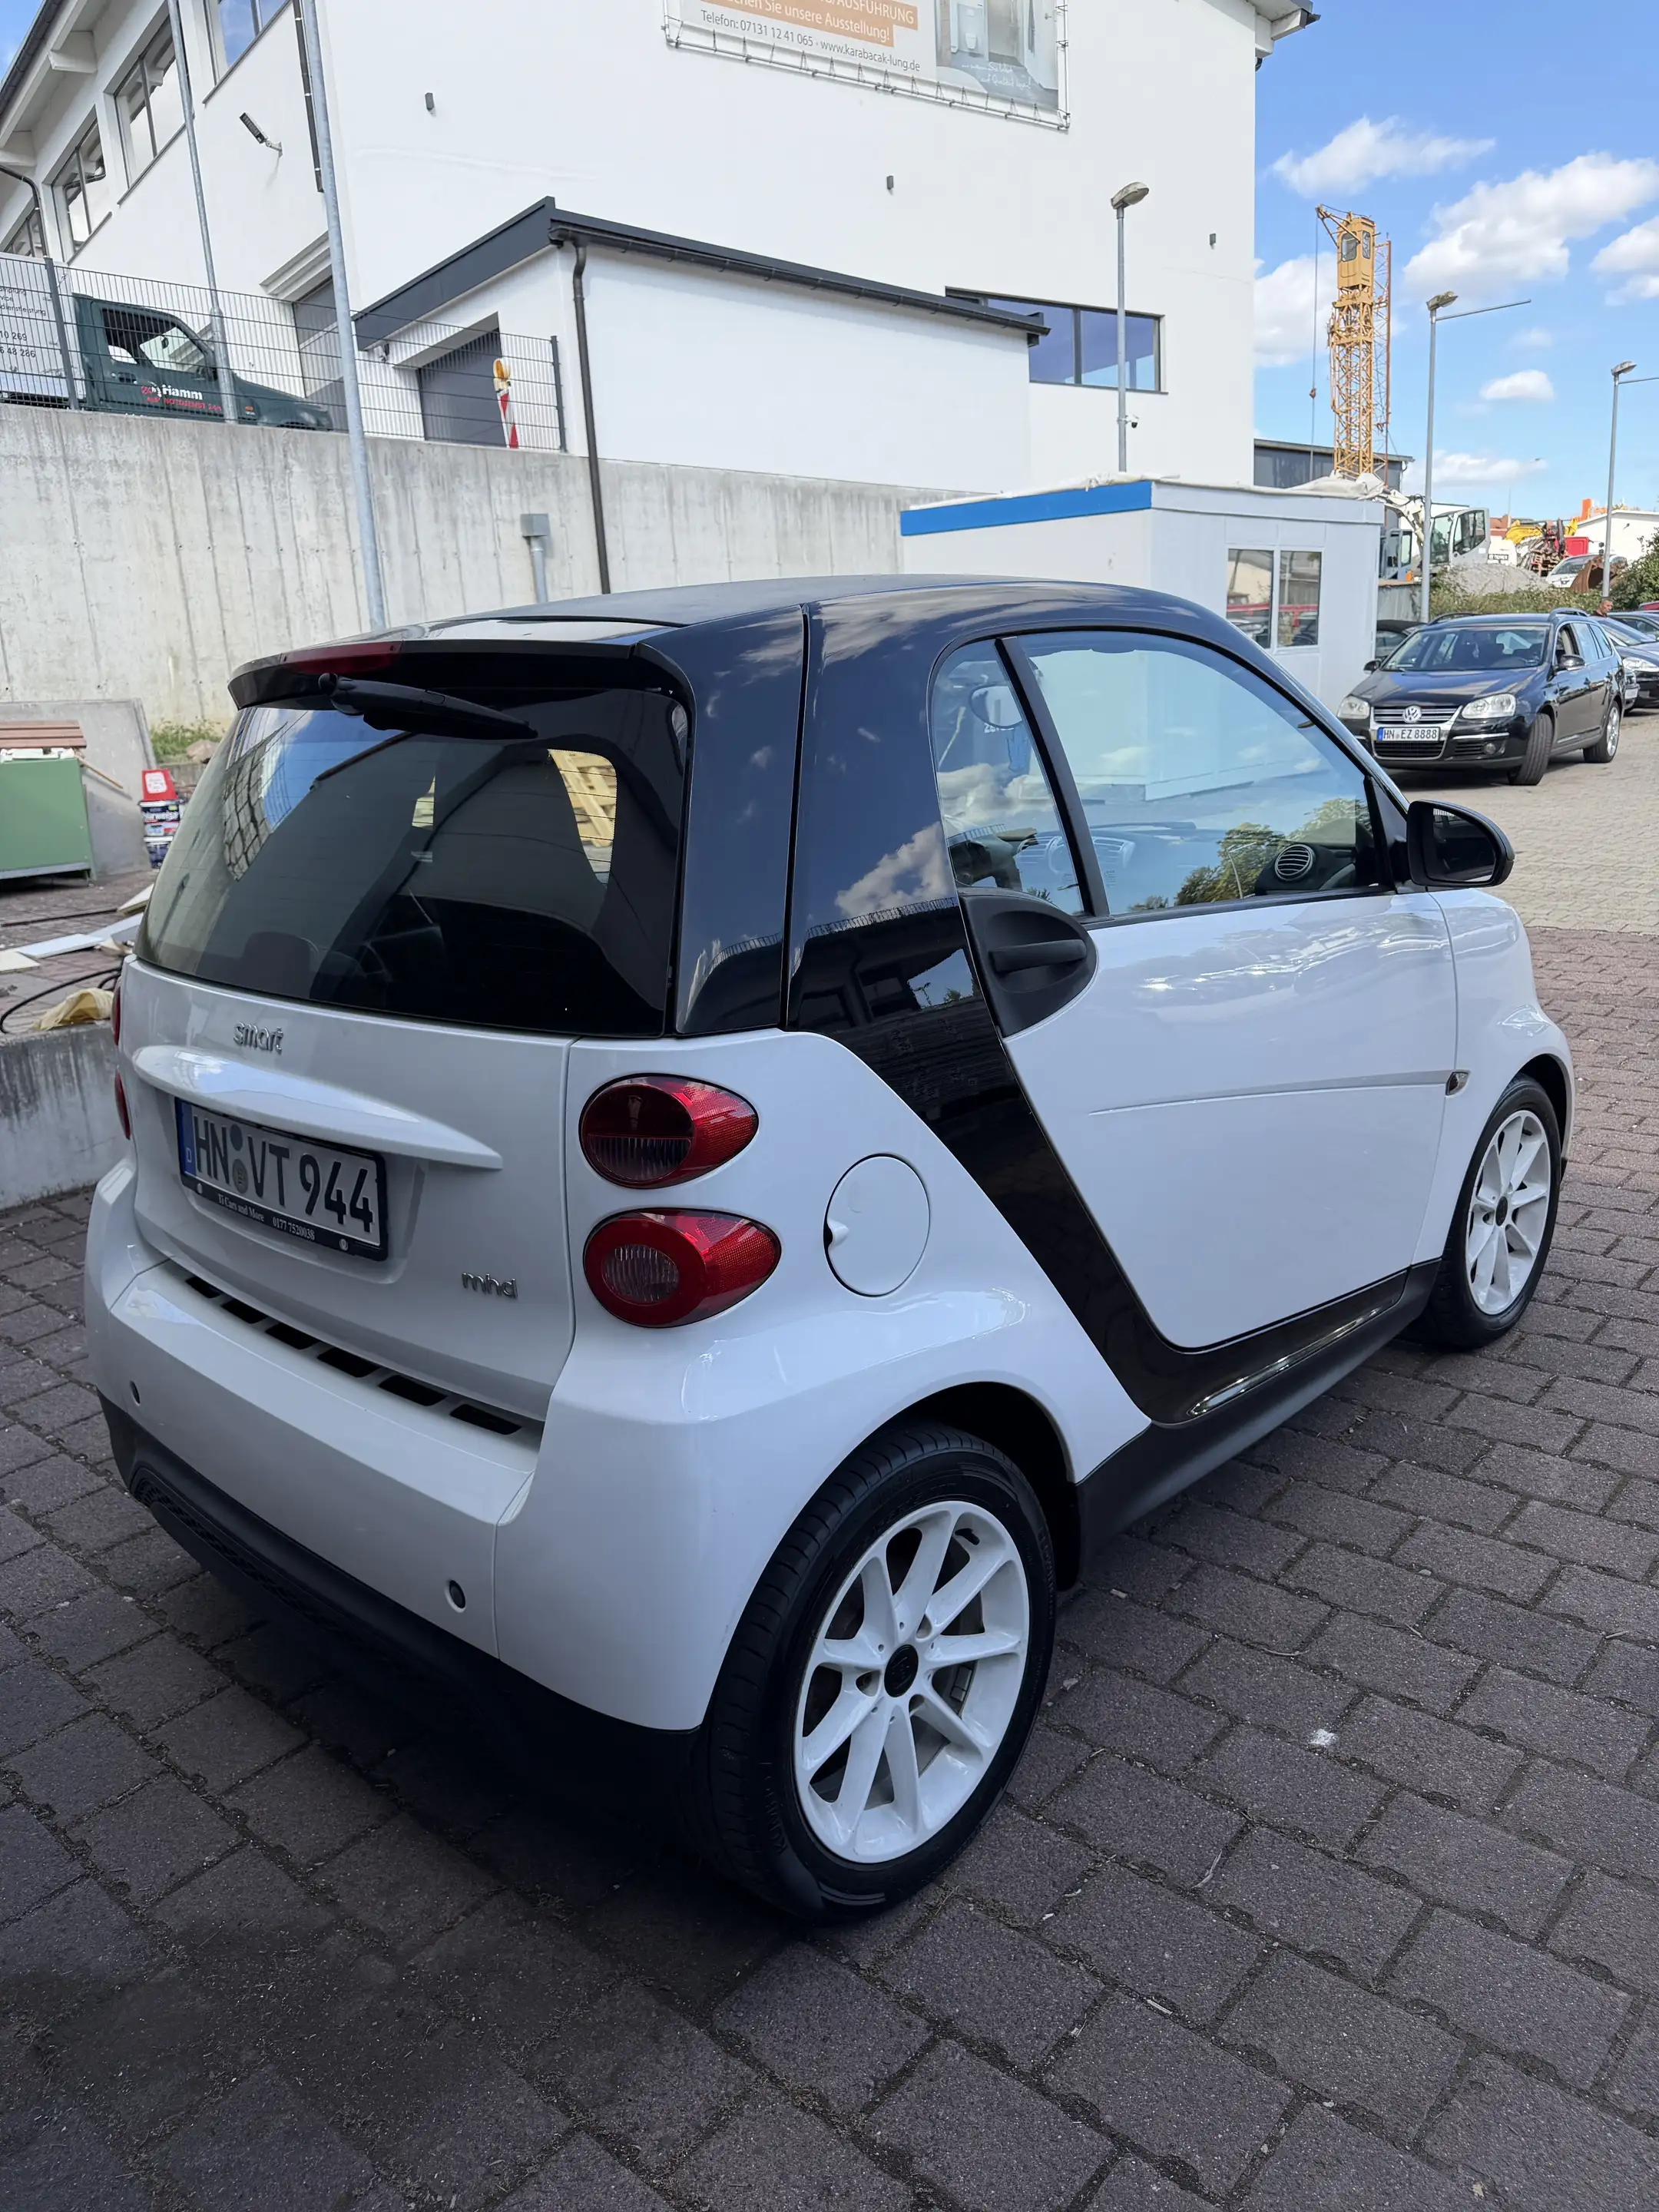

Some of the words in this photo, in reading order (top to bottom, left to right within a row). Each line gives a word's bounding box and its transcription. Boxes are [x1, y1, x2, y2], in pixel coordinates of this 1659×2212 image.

[765, 0, 783, 14] Sie
[784, 5, 822, 24] unsere
[825, 12, 890, 42] Ausstellung!
[700, 9, 739, 29] Telefon:
[740, 20, 768, 36] 07131
[771, 28, 782, 39] 12
[783, 30, 794, 42] 41
[796, 34, 813, 47] 065
[820, 40, 921, 71] www.karabacak-lung.de
[12, 331, 27, 341] 269
[1383, 729, 1395, 739] HN
[1401, 729, 1412, 740] EZ
[1414, 729, 1437, 739] 8888
[233, 1021, 283, 1055] smart
[194, 1115, 230, 1186] HN
[247, 1135, 290, 1207] VT
[299, 1153, 373, 1233] 944
[273, 1217, 287, 1230] 0177
[462, 1271, 518, 1300] mhd
